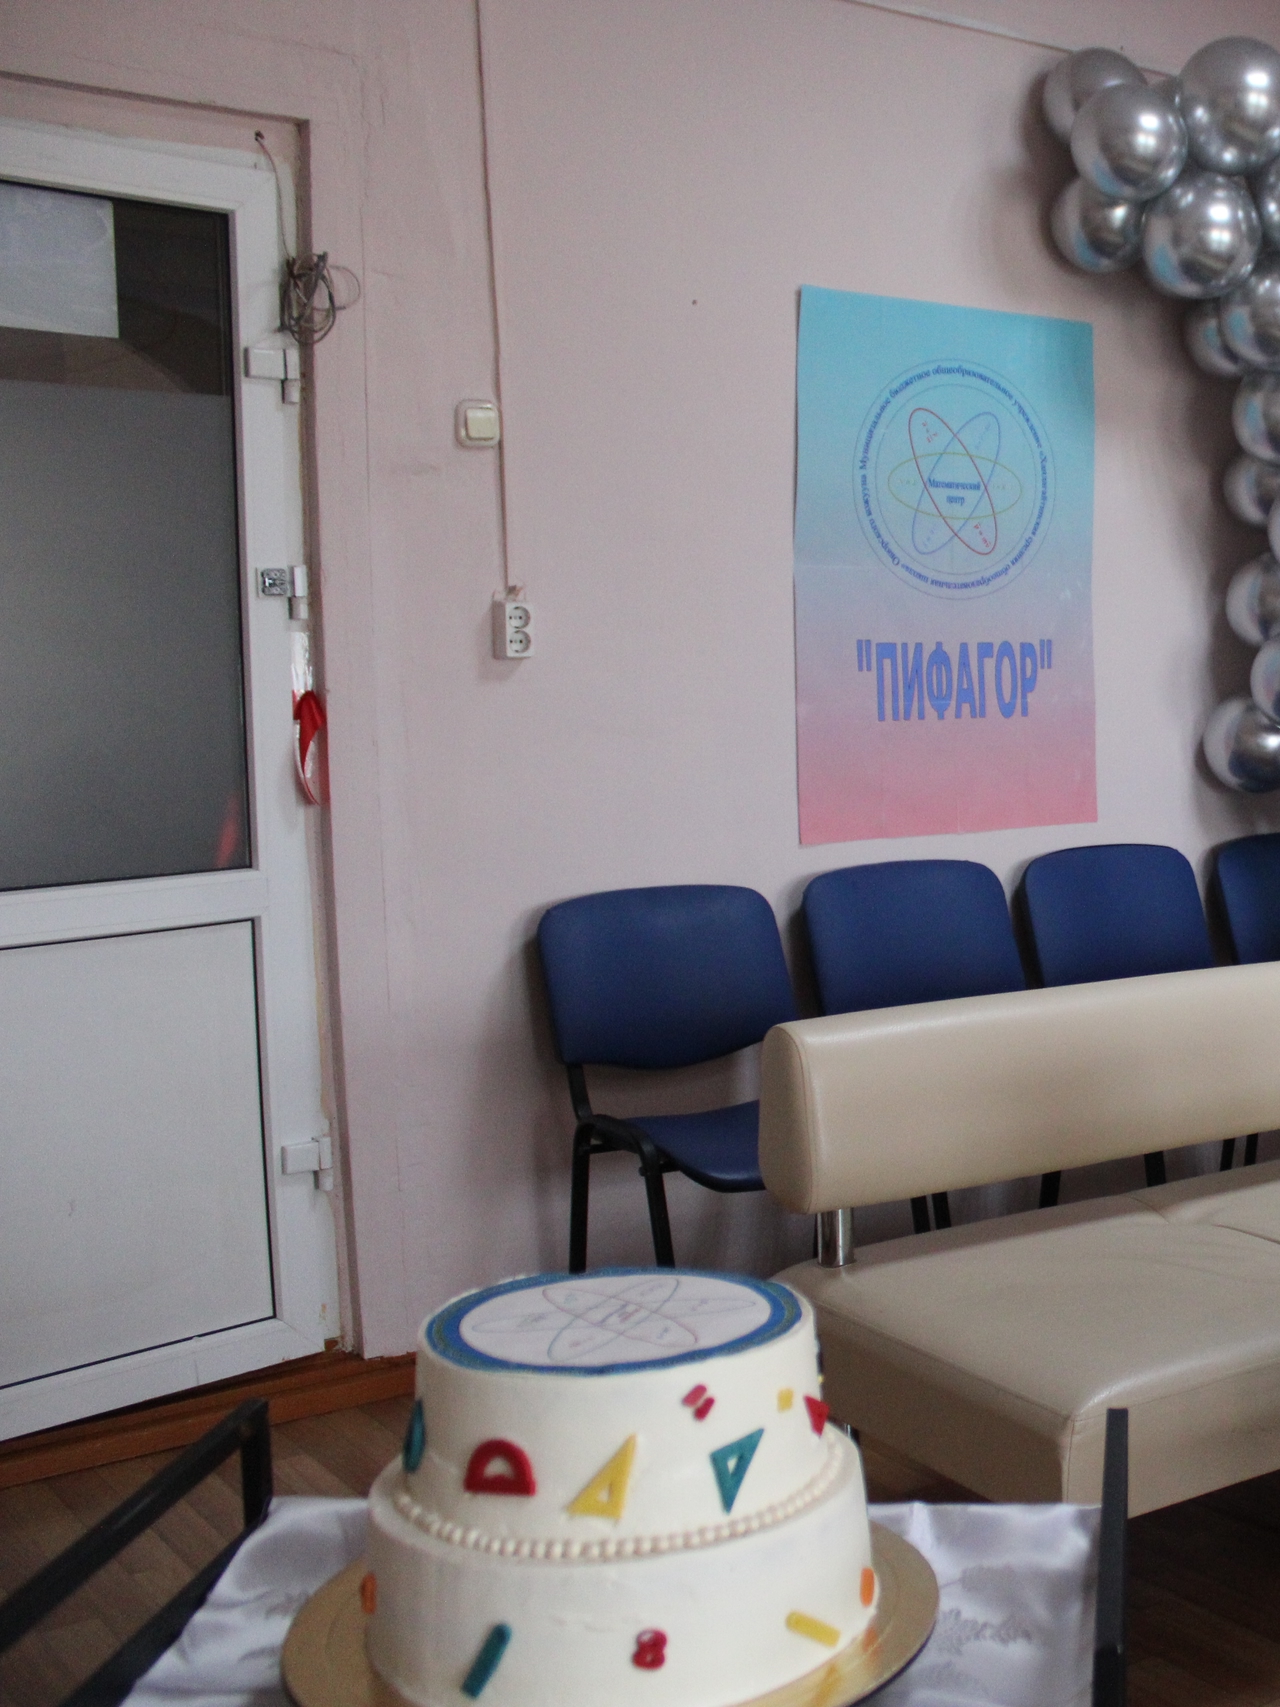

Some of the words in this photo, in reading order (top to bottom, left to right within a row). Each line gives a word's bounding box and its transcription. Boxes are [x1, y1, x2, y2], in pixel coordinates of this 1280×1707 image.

[889, 367, 931, 398] бюджетное
[932, 365, 1014, 399] общеобразовательное
[860, 396, 891, 470] Муниципальное
[1012, 397, 1042, 448] учреждение
[928, 479, 981, 493] Математический
[946, 495, 965, 506] центр
[1010, 534, 1034, 566] средняя
[931, 563, 1010, 590] общеобразовательная
[856, 639, 1052, 721] "ПИФАГОР"
[632, 1629, 667, 1669] 8
